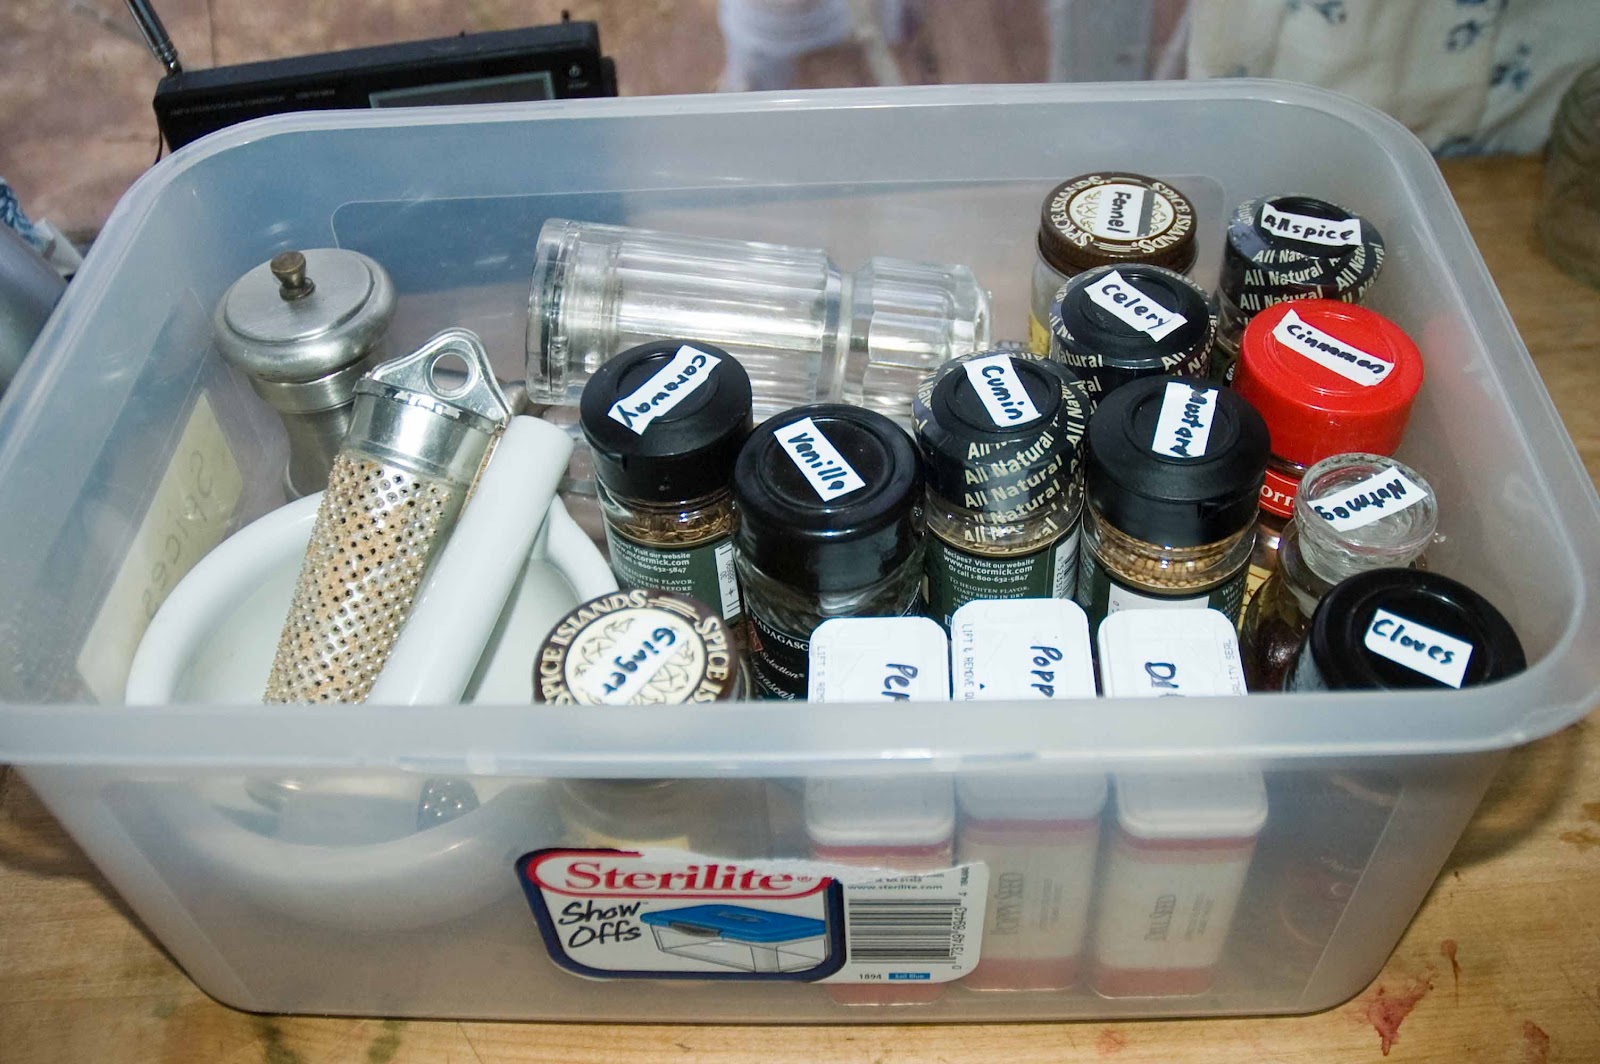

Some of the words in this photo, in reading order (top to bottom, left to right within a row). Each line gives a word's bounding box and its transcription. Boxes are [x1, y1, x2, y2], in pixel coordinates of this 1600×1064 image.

[1106, 190, 1132, 234] Fennel
[1263, 214, 1354, 241] Allspice
[1252, 250, 1275, 264] All
[1244, 268, 1265, 286] All
[1268, 260, 1324, 287] Natural
[1335, 267, 1358, 292] All
[1101, 283, 1171, 329] Celery
[1240, 293, 1261, 311] All
[1160, 351, 1187, 371] All
[1286, 324, 1386, 374] Cinnamon
[981, 364, 1025, 420] Cumin
[1066, 420, 1086, 449] All
[787, 431, 845, 491] Vanilla
[965, 466, 989, 485] All
[990, 431, 1054, 478] Natural
[967, 442, 991, 460] All
[964, 490, 989, 508] All
[991, 454, 1063, 502] Natural
[989, 479, 1061, 524] Natural
[1314, 478, 1407, 522] Nutmeg
[943, 547, 972, 564] Recipes?
[974, 559, 992, 569] Visit
[1006, 558, 1035, 569] website
[943, 554, 1033, 576] www.mccormick.com
[957, 567, 969, 577] call
[970, 574, 1029, 583] 1-800-632-5847
[959, 580, 998, 594] HEIGHTEN
[953, 585, 974, 596] TOAST
[694, 615, 729, 681] SPICE
[962, 623, 974, 645] LIFT
[1371, 618, 1456, 666] Cloves
[602, 626, 676, 696] Ginger
[565, 862, 794, 892] Sterilite
[558, 899, 642, 926] Show
[568, 920, 643, 949] Offs
